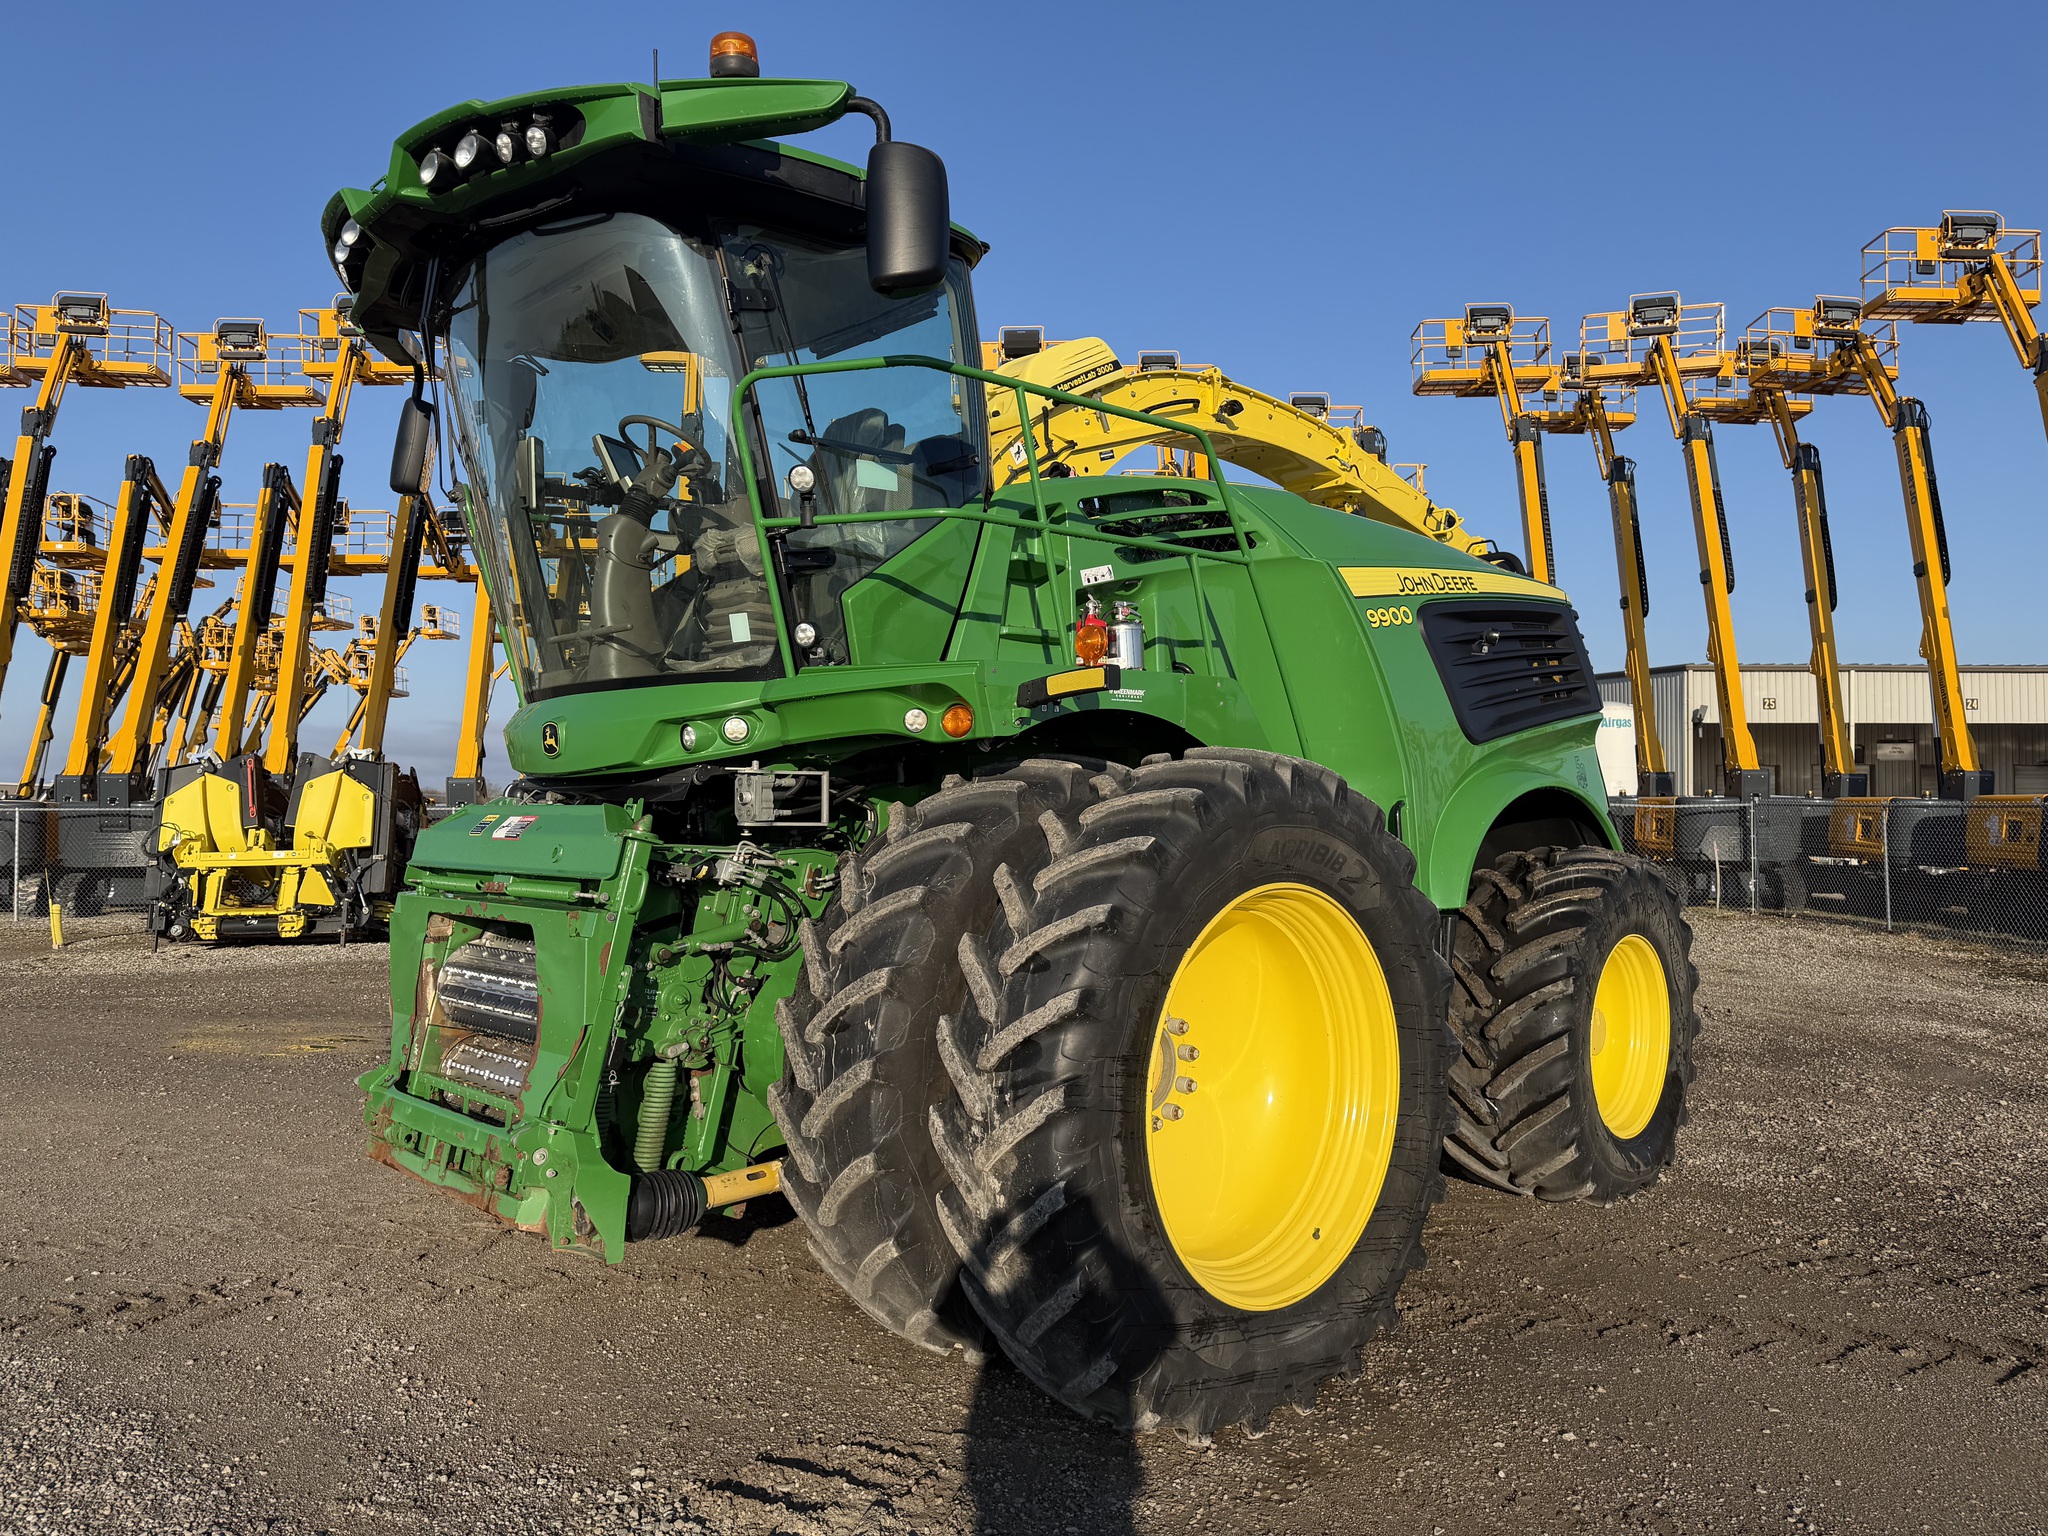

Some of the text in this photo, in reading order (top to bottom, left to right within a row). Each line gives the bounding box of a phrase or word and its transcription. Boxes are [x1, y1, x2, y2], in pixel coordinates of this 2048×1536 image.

[1057, 363, 1114, 392] HarvestLab 3000
[1907, 474, 1918, 505] RTJO
[1366, 605, 1413, 628] 9900
[1938, 671, 1948, 706] Haulotte
[1763, 698, 1776, 709] 25
[1966, 699, 1978, 710] 24
[1601, 717, 1632, 728] Airgas
[1267, 838, 1370, 896] AGRIBIB 2
